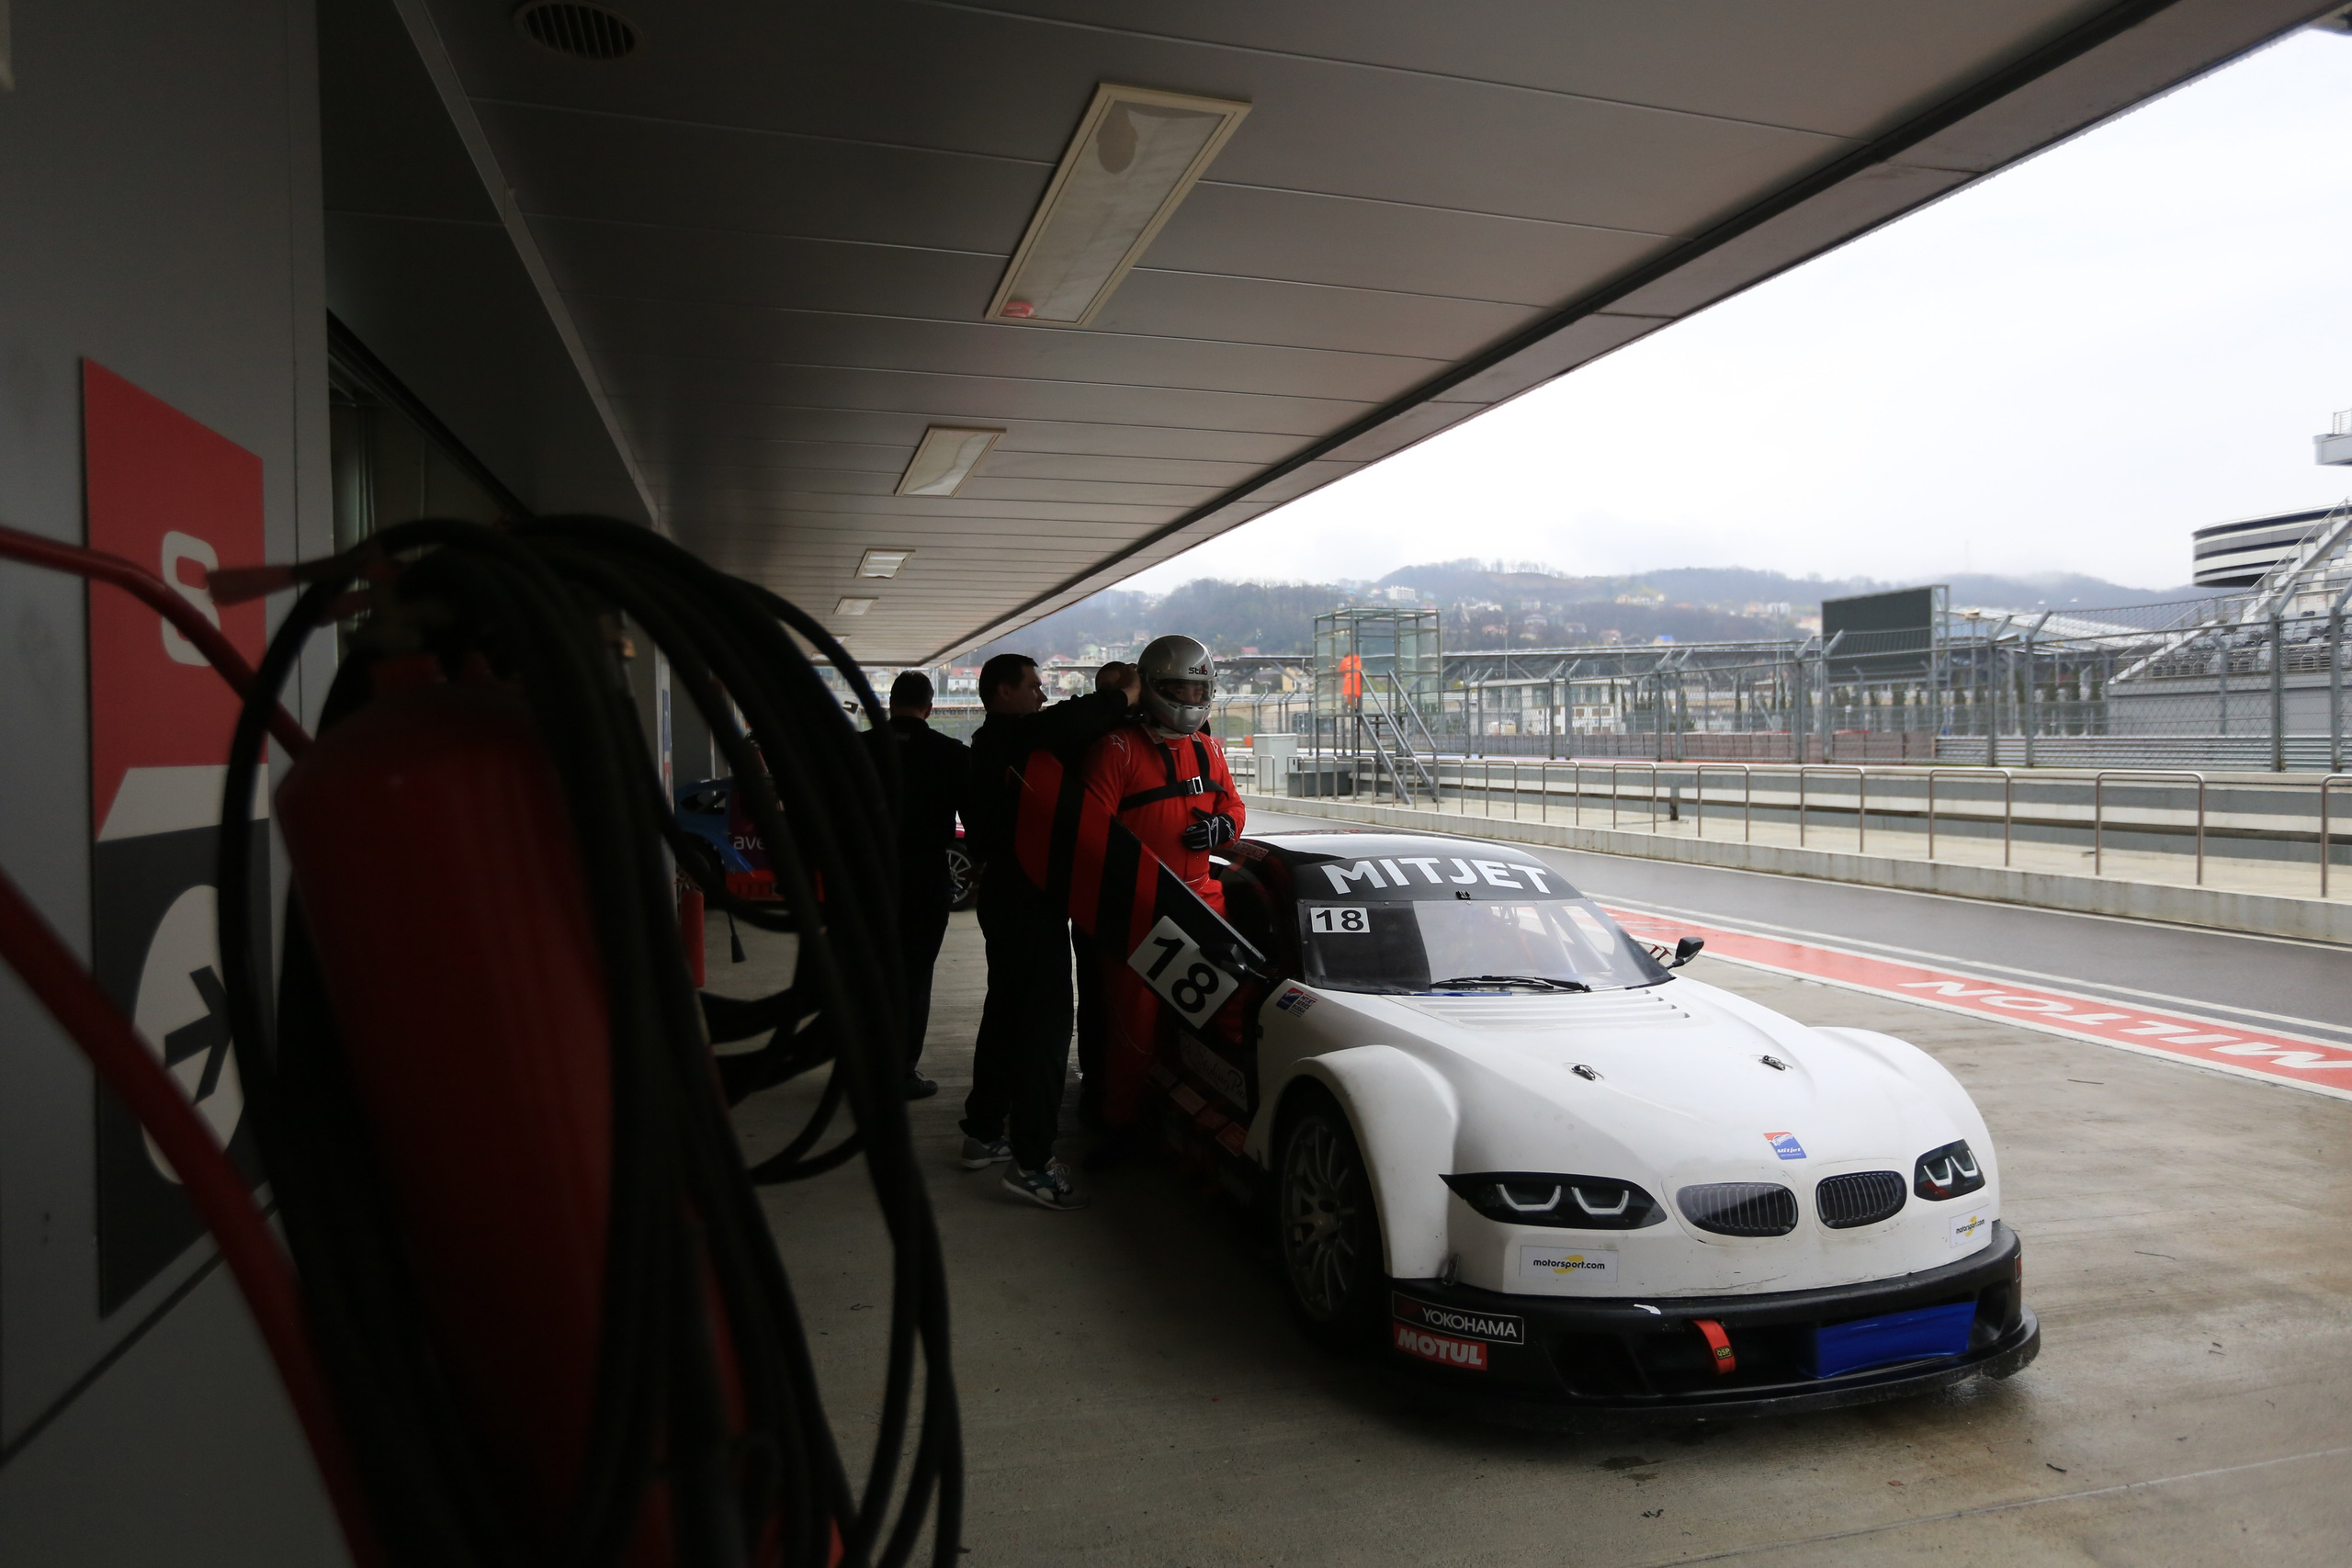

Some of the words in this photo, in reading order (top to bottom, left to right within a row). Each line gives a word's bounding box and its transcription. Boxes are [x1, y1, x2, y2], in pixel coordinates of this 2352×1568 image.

[1320, 857, 1551, 895] MITJET
[1316, 909, 1364, 931] 18
[1147, 936, 1219, 1014] 18
[1955, 1219, 1984, 1234] motorsport.com
[1533, 1259, 1605, 1269] motorsport.com
[1422, 1307, 1518, 1337] YOKOHAMA
[1397, 1328, 1482, 1365] MOTUL
[1716, 1348, 1730, 1357] QSP
